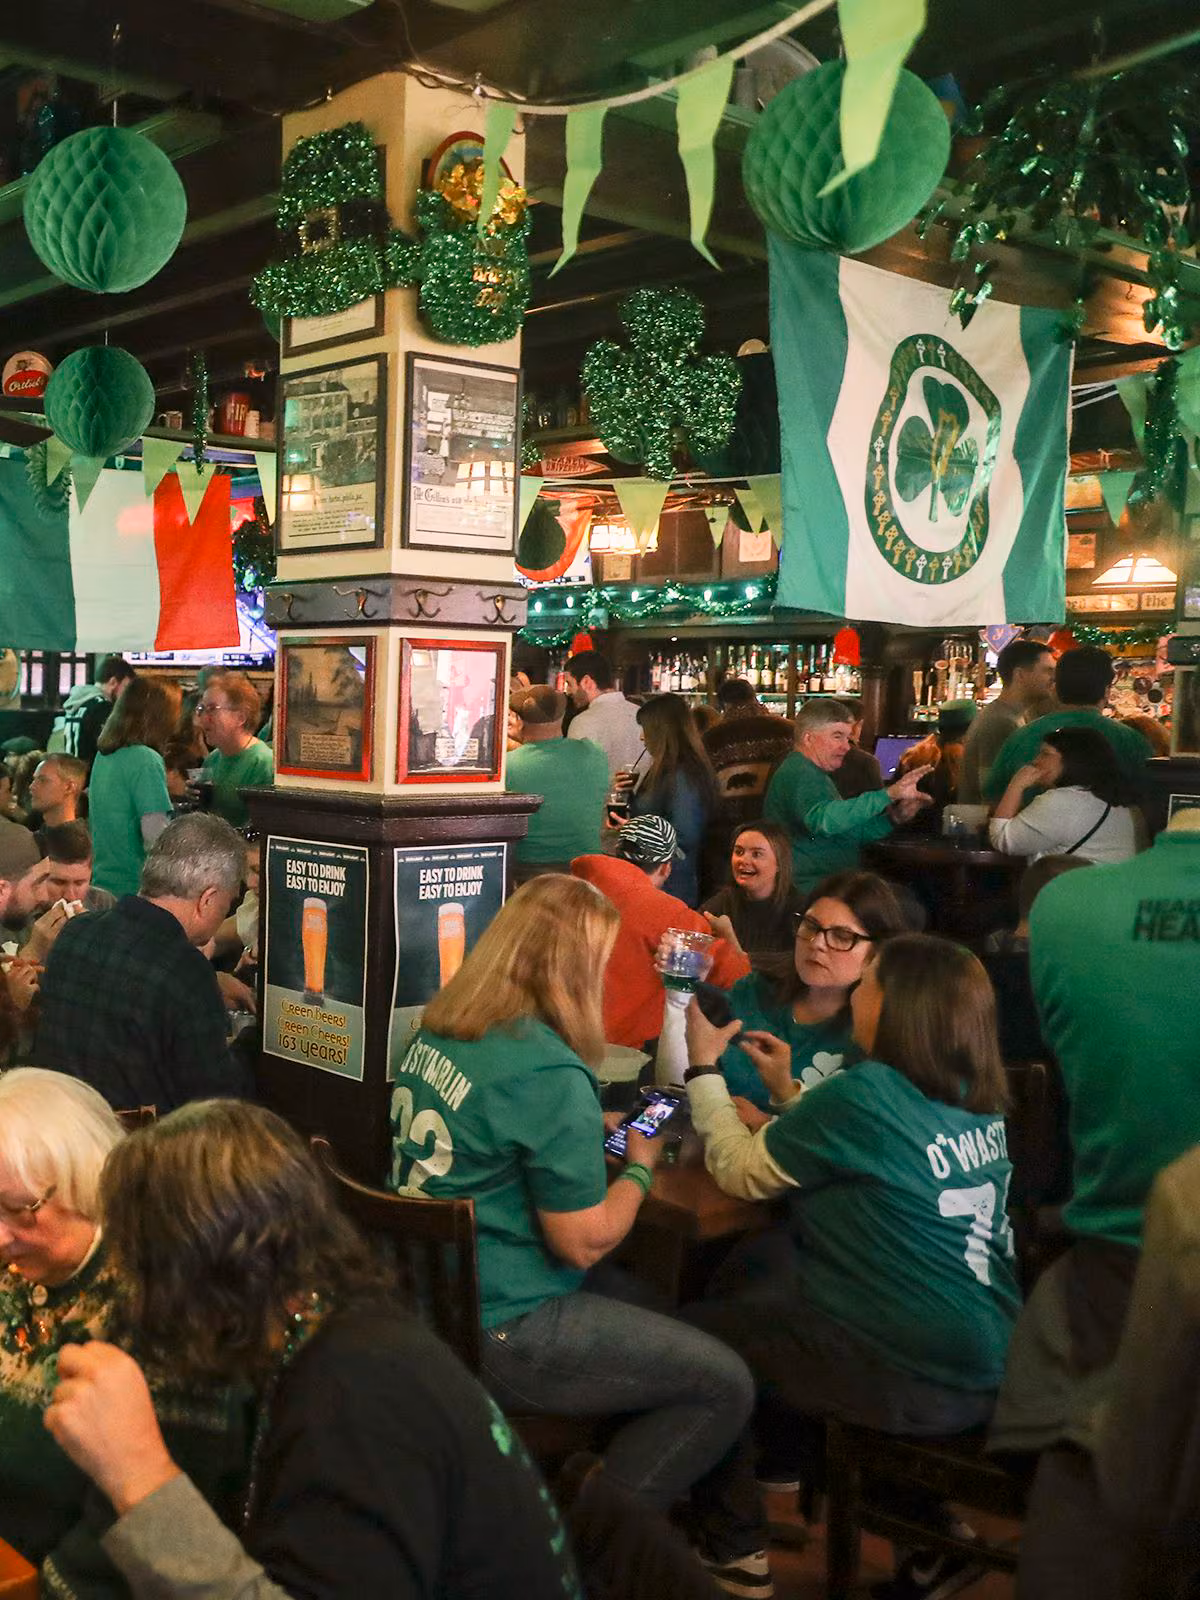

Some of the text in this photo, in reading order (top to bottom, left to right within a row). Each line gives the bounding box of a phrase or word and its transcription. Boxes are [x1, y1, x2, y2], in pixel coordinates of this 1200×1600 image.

[1145, 595, 1169, 607] the
[286, 859, 346, 882] EASY TO DRINK
[419, 865, 484, 885] EASY TO DRINK
[286, 875, 345, 897] EASY TO ENJOY
[419, 881, 483, 900] EASY TO ENJOY
[281, 999, 346, 1028] Green Beers!
[278, 1033, 297, 1051] 163
[311, 1024, 350, 1048] Cheers!
